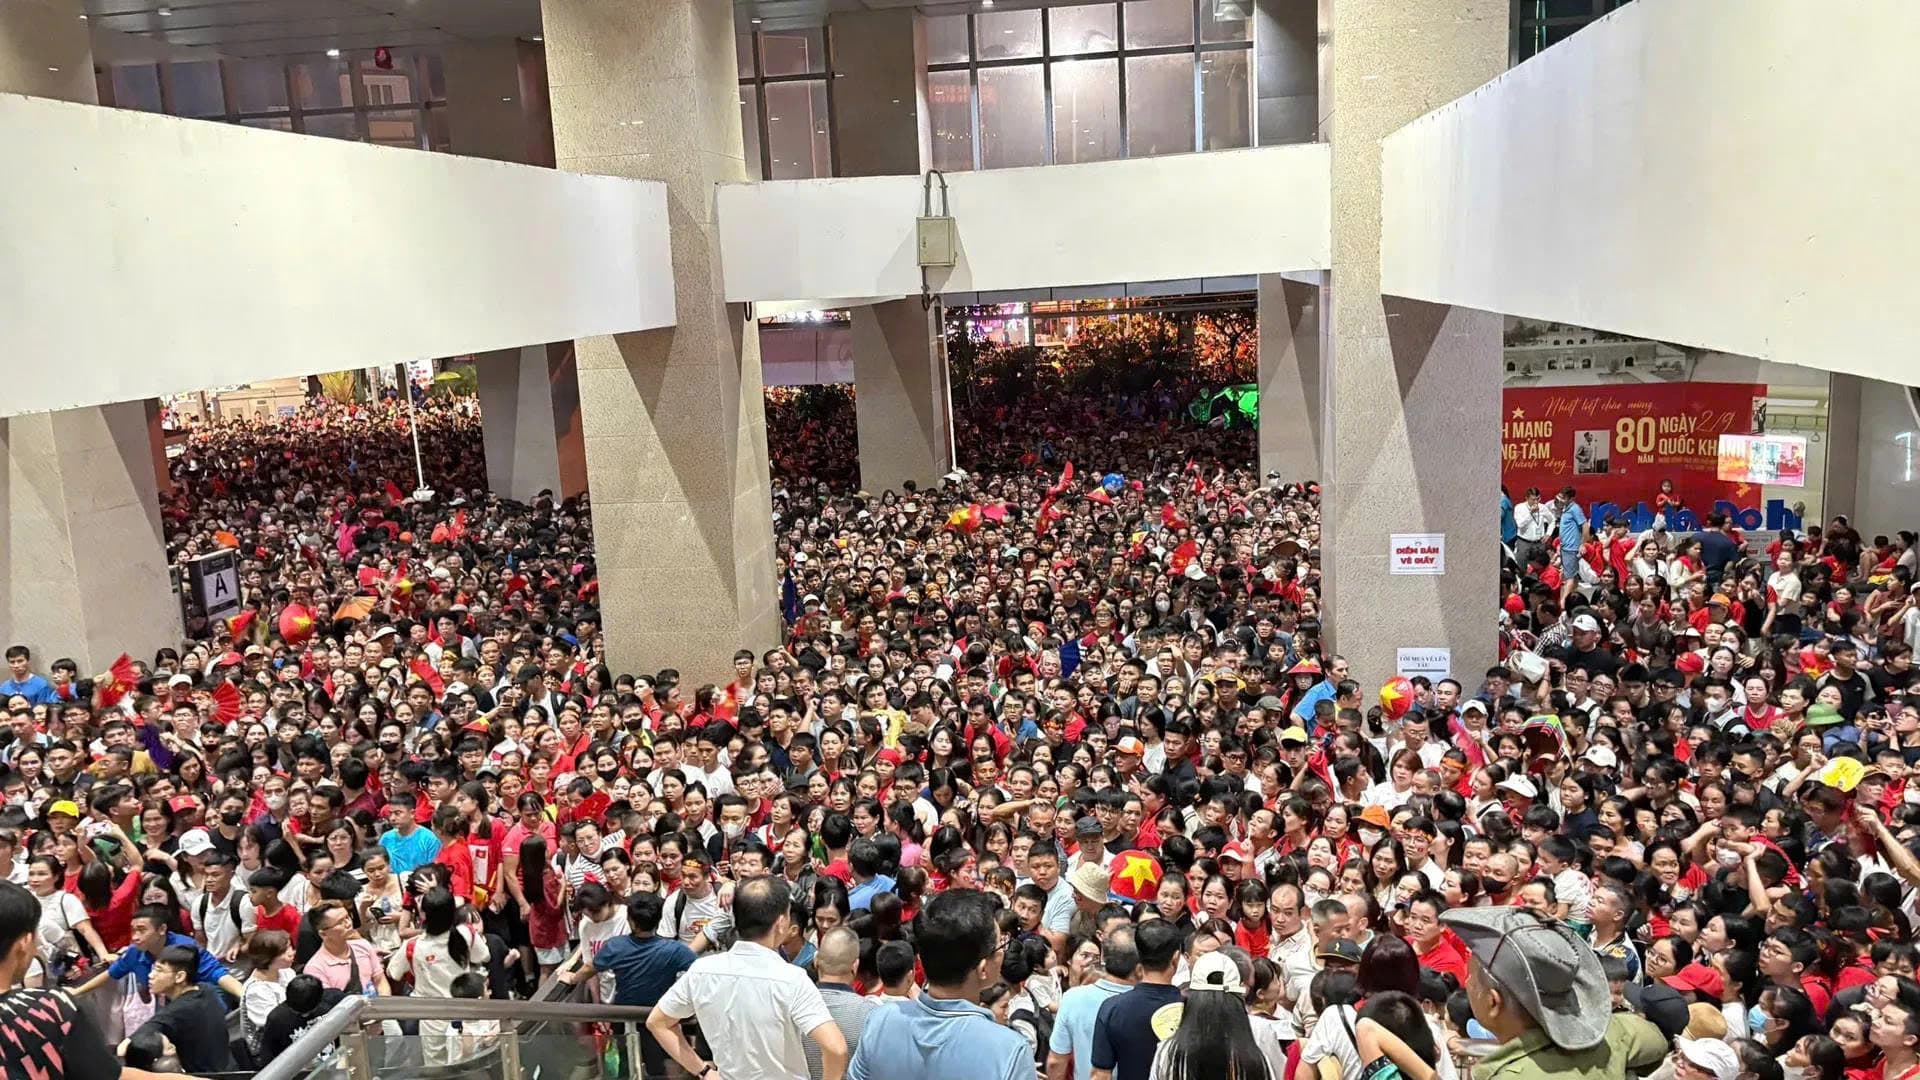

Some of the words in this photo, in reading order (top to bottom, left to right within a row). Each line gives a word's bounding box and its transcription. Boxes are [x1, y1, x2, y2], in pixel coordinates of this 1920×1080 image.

[1512, 420, 1553, 442] MẠNG
[1615, 416, 1656, 454] 80
[1659, 412, 1697, 434] NGÀY
[1696, 410, 1737, 433] 2/9
[1521, 439, 1551, 460] TÁM
[1659, 433, 1695, 456] QUỐC
[1637, 454, 1655, 465] NĂM
[215, 572, 228, 598] A
